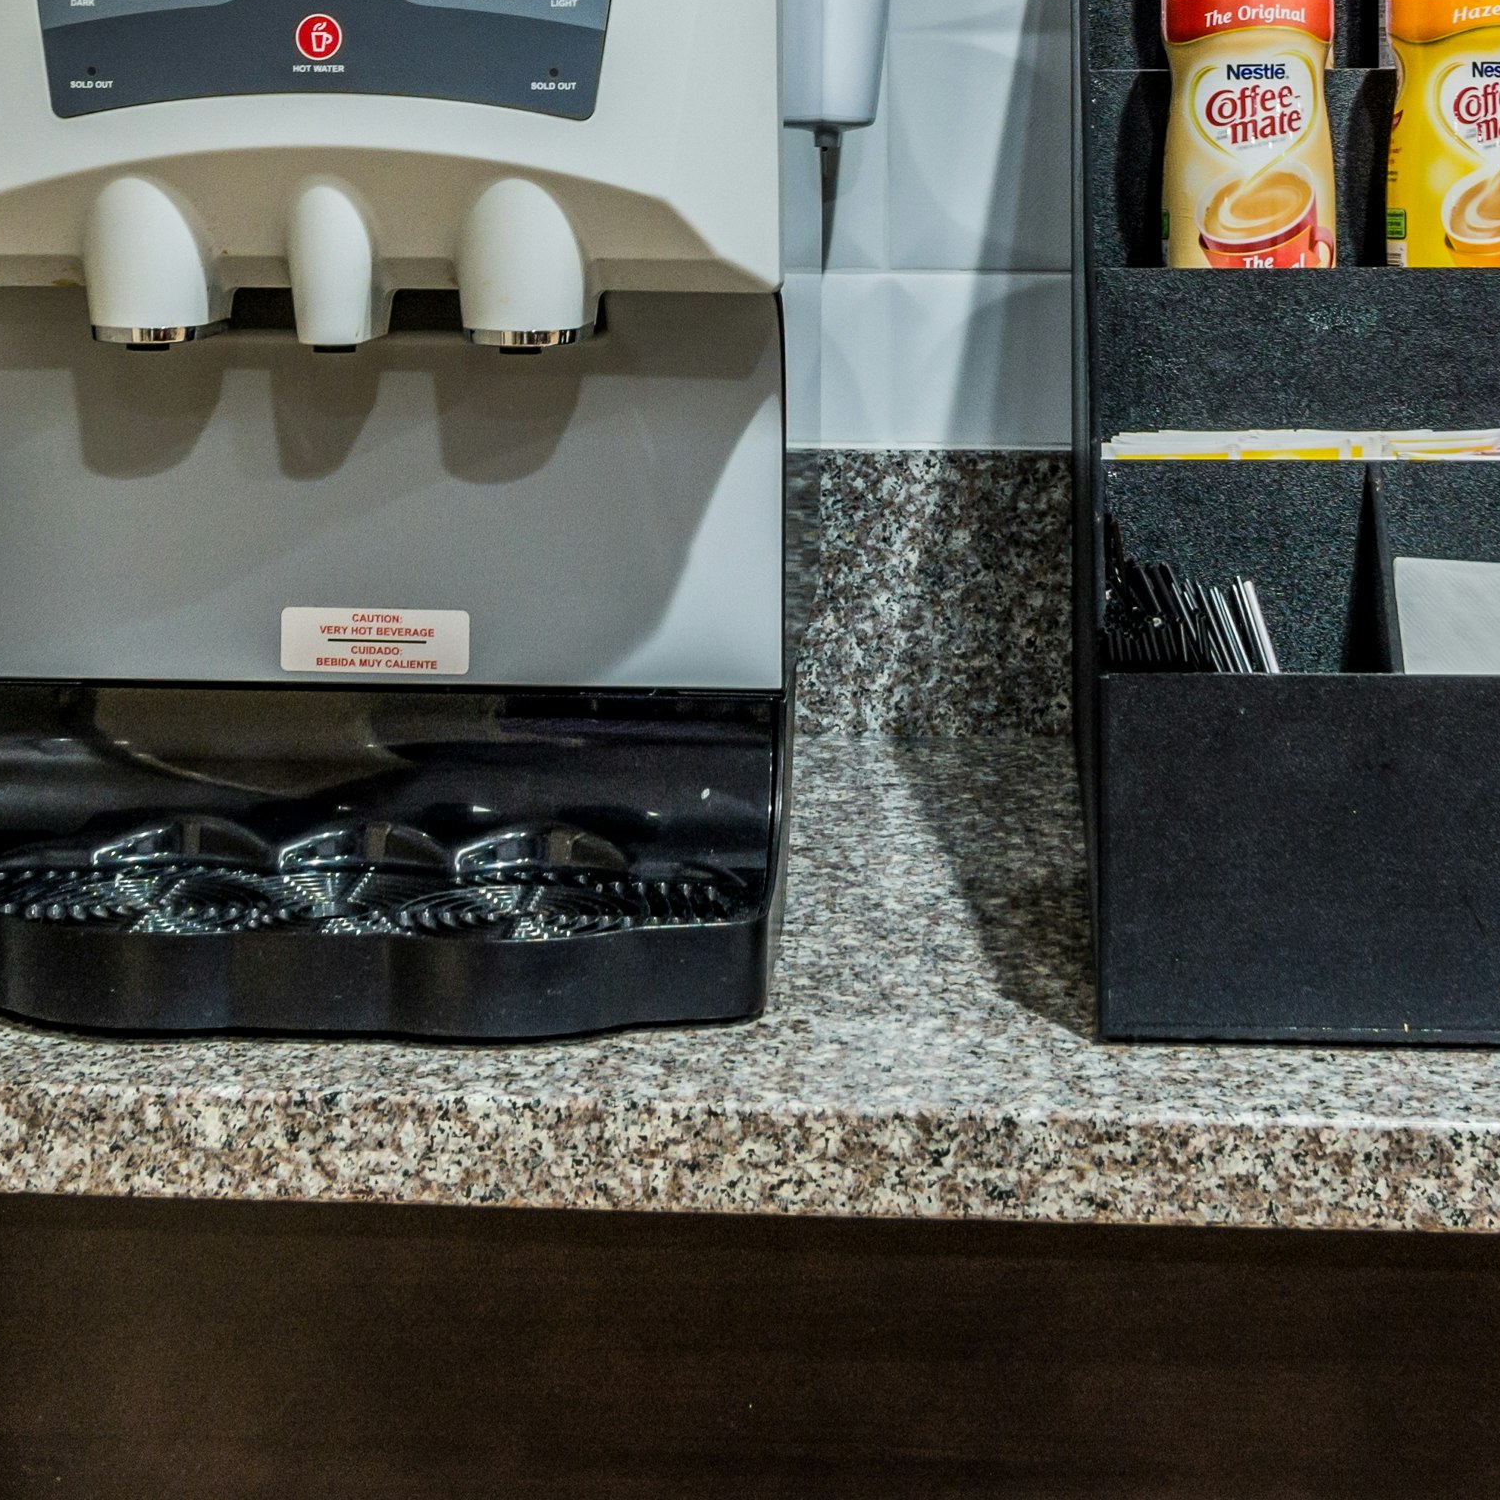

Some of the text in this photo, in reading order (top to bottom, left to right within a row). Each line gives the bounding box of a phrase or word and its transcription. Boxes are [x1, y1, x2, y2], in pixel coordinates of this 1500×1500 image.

[70, 0, 95, 7] DARK
[550, 0, 577, 8] LIGHT
[1204, 4, 1307, 28] The Original
[293, 65, 345, 73] HOT WATER
[70, 80, 113, 89] SOLD OUT
[531, 82, 576, 90] SOLD OUT
[1231, 109, 1302, 145] mate
[352, 613, 403, 624] CAUTION:
[320, 625, 435, 637] VERY HOT BEVERAGE
[350, 645, 403, 656] CUIDADO:
[316, 657, 438, 670] BEBIDA MUY CALIENTE
